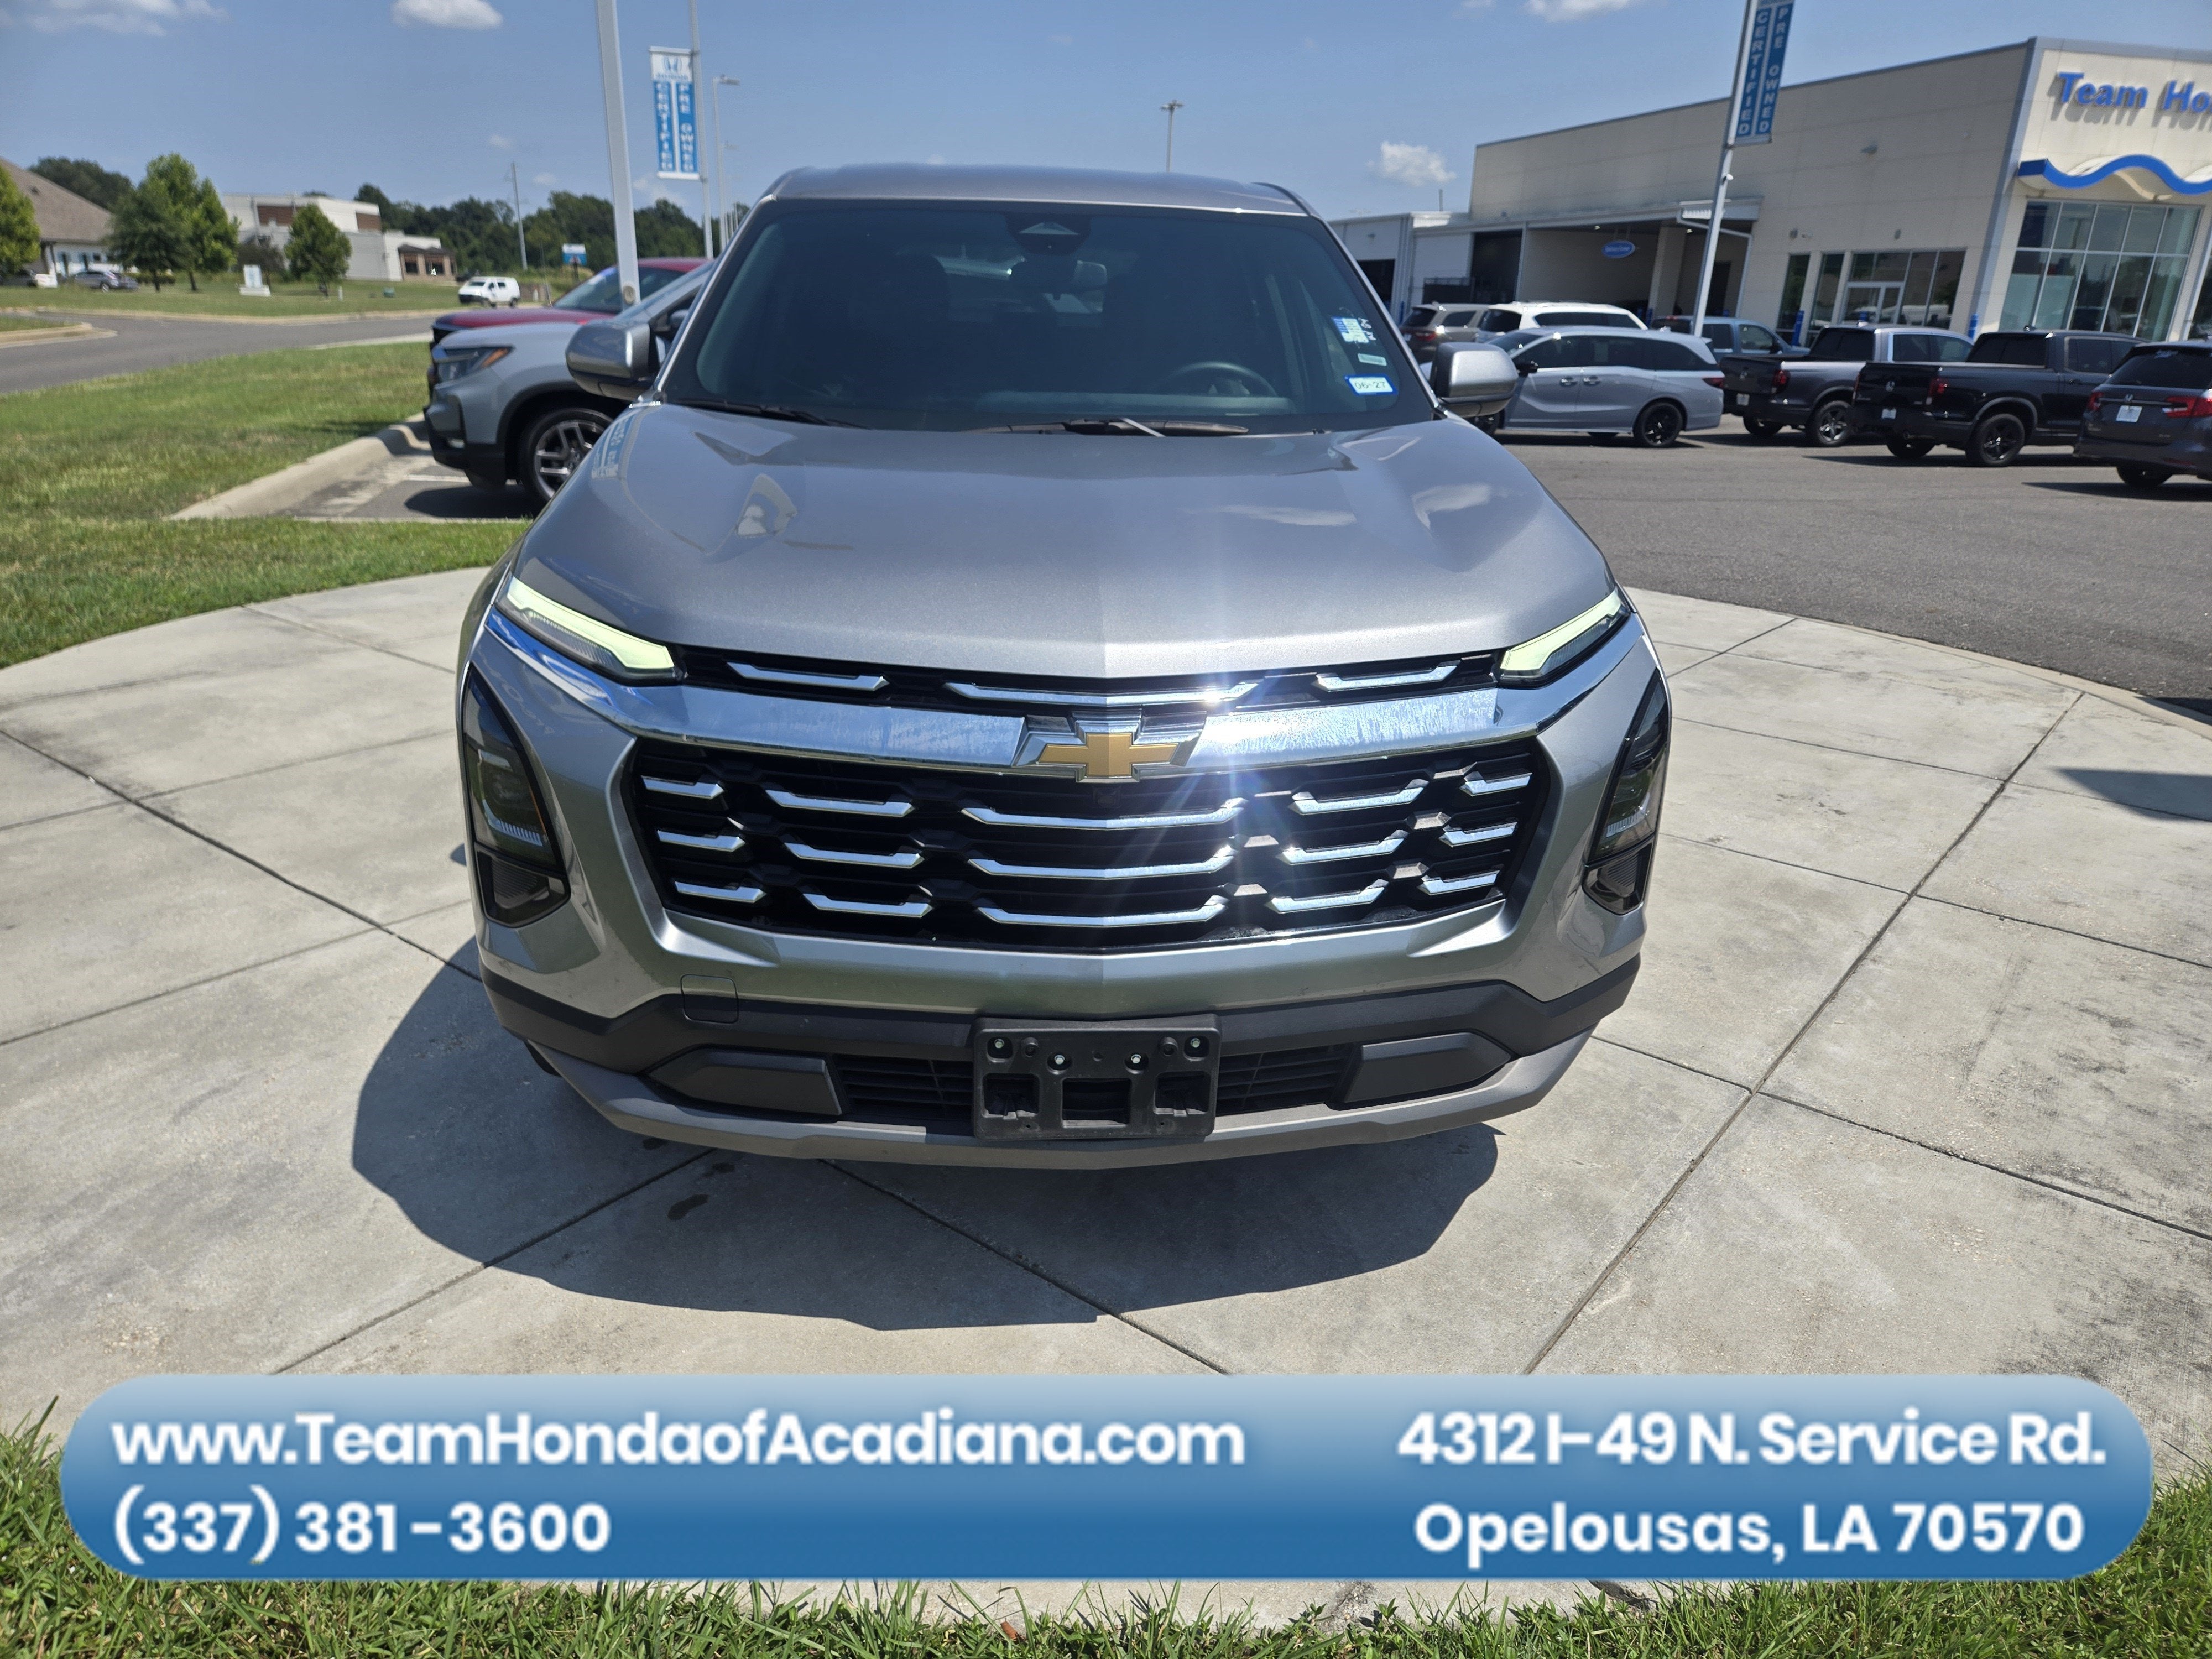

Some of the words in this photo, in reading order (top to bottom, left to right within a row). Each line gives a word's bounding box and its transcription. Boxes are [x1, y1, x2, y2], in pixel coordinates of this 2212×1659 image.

[1773, 7, 1789, 49] PRE
[1738, 11, 1769, 135] CERTIFIED
[1759, 64, 1780, 133] OWNED
[2057, 71, 2149, 109] Team
[2162, 79, 2212, 114] Ho
